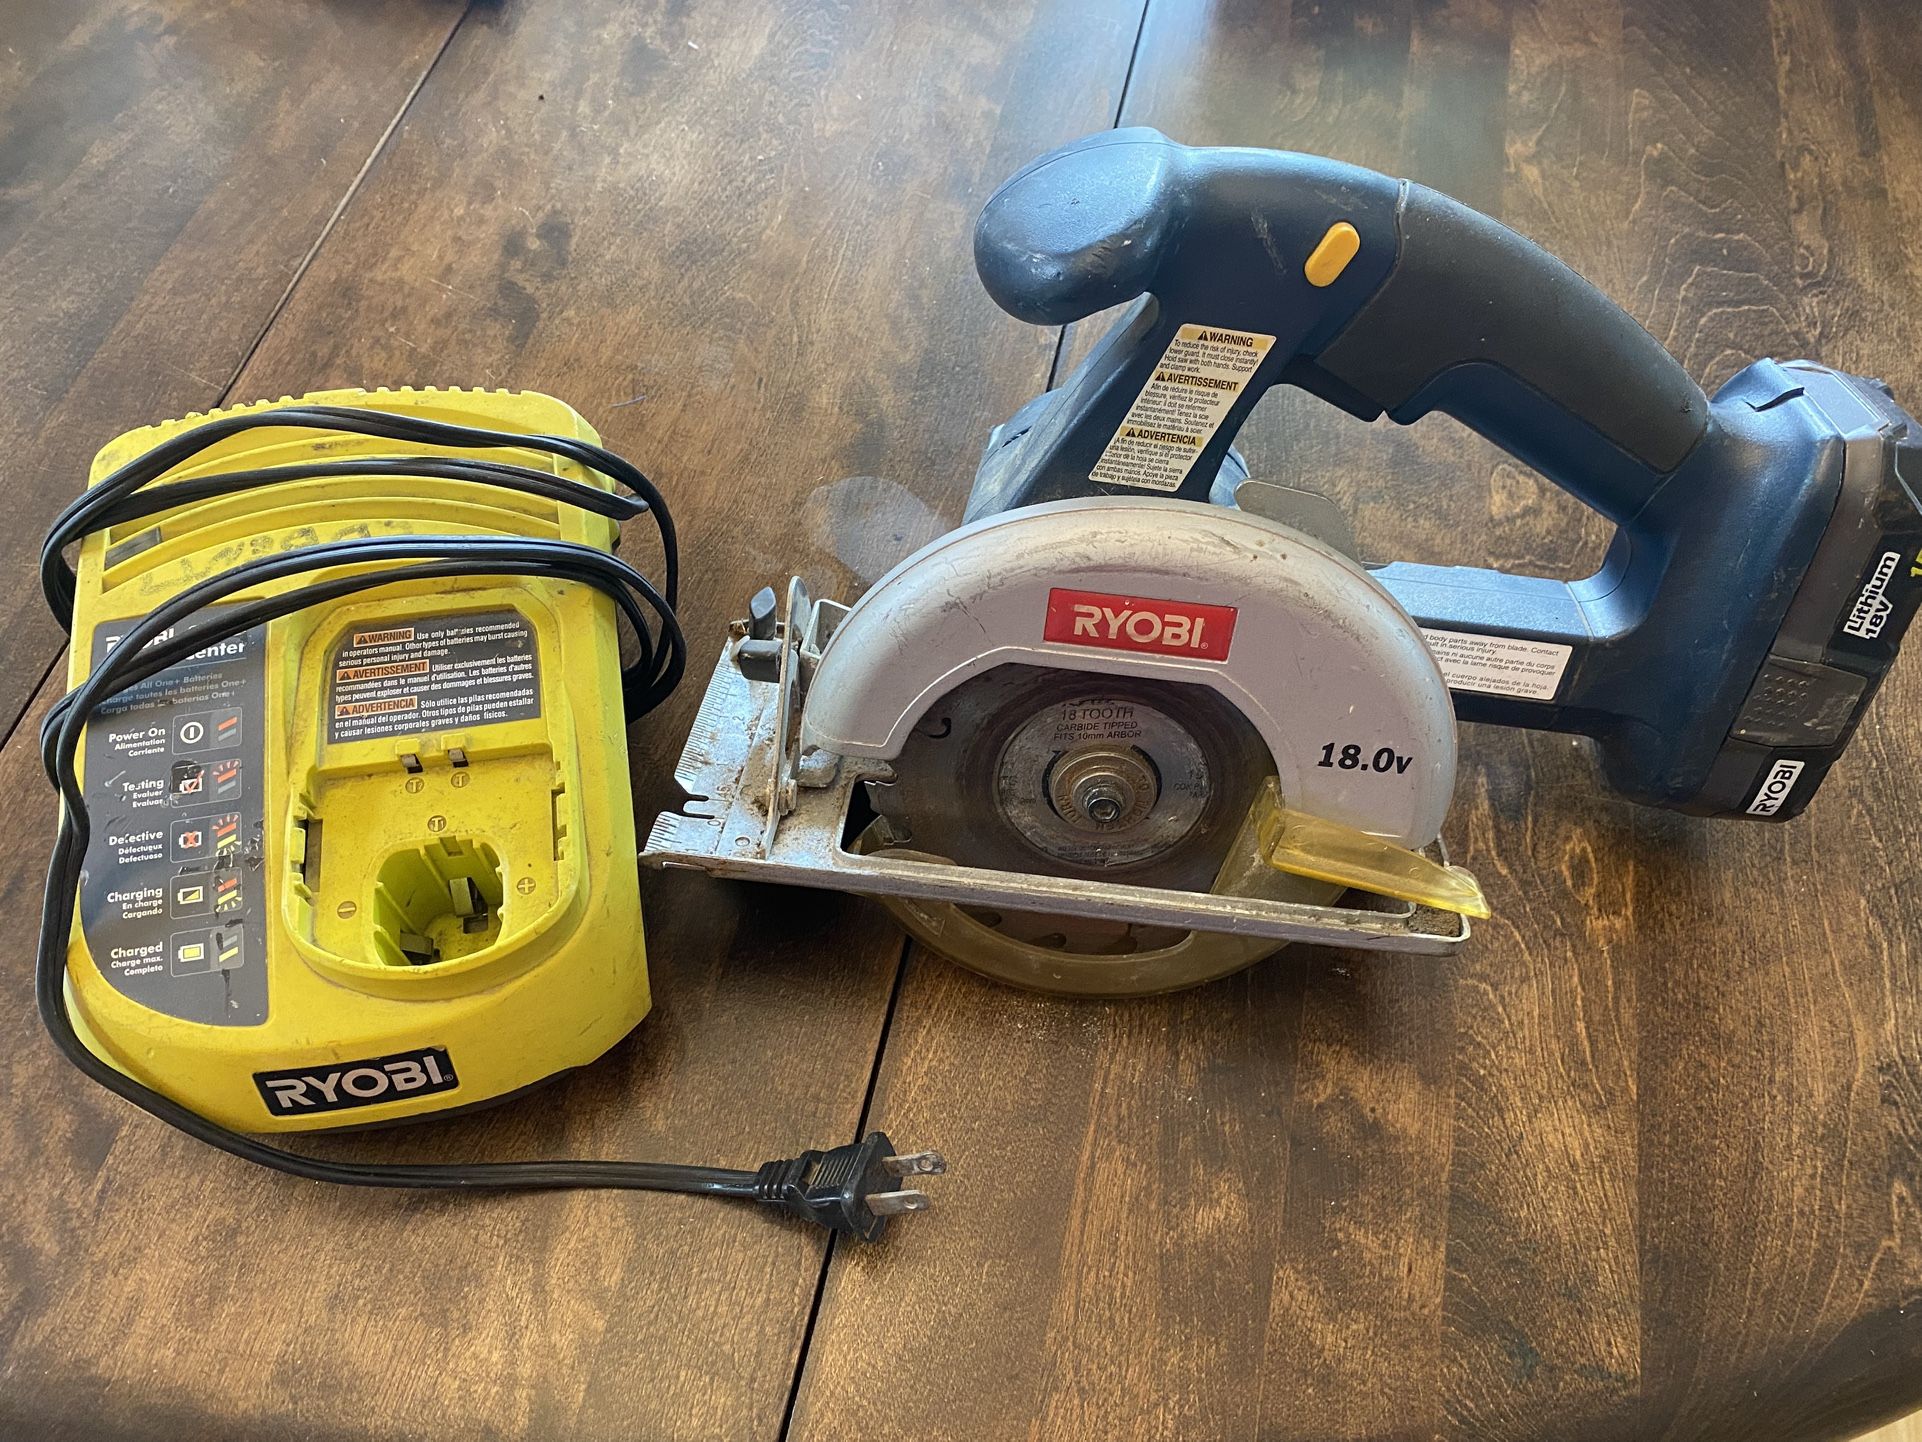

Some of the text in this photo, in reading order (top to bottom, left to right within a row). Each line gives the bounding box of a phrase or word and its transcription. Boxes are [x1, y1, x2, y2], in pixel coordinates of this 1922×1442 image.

[1174, 339, 1180, 347] To
[1181, 341, 1199, 349] reduce
[1209, 344, 1219, 352] risk
[1219, 345, 1226, 353] of
[1209, 331, 1254, 347] WARNING
[1169, 346, 1184, 355] lower
[1220, 354, 1234, 362] close
[1164, 354, 1176, 362] Hold
[1200, 359, 1212, 367] both
[1231, 363, 1252, 372] Support
[1170, 363, 1186, 372] clamp
[1166, 373, 1239, 391] AVERTISSEMENT
[1136, 429, 1197, 446] ADVERTENCIA
[1847, 556, 1896, 632] Lithium
[1865, 600, 1890, 635] 18V
[368, 630, 412, 644] WARNING
[431, 630, 444, 638] only
[475, 621, 519, 632] recommended
[1073, 604, 1205, 648] RYOBI
[349, 648, 378, 657] operators
[379, 644, 402, 653] manual.
[405, 642, 422, 650] Other
[422, 640, 439, 649] types
[439, 638, 446, 646] of
[446, 636, 473, 645] batteries
[487, 632, 503, 640] burst
[504, 630, 527, 638] causing
[1429, 635, 1447, 643] body
[1531, 647, 1559, 656] Contact
[339, 648, 450, 667] serious personal injury and damage.
[352, 662, 428, 679] AVERTISSEMENT
[432, 663, 453, 671] Utiliser
[454, 658, 495, 669] exclusivement
[506, 654, 532, 662] batteries
[140, 680, 153, 689] All
[183, 672, 223, 684] Batteries
[336, 681, 381, 692] recommandées
[383, 679, 397, 687] dans
[399, 677, 405, 685] le
[407, 674, 429, 683] manuel
[481, 666, 507, 674] batteries
[508, 663, 532, 671] d'autres
[135, 690, 163, 700] toutes
[165, 688, 178, 696] les
[180, 684, 219, 694] batteries
[335, 694, 351, 703] types
[352, 690, 376, 701] peuvent
[377, 688, 402, 697] exploser
[442, 679, 475, 688] dommages
[476, 677, 482, 685] et
[483, 675, 511, 683] blessures
[512, 672, 533, 681] graves.
[130, 701, 155, 710] todas
[351, 698, 415, 715] ADVERTENCIA
[420, 700, 435, 708] Sólo
[436, 698, 456, 706] utilice
[468, 694, 484, 704] pilas
[485, 688, 532, 700] recomendadas
[344, 719, 351, 727] el
[352, 716, 376, 726] manual
[377, 714, 388, 723] del
[389, 712, 420, 722] operador.
[421, 709, 439, 717] Otros
[440, 707, 456, 716] tipos
[457, 705, 465, 713] de
[466, 704, 482, 713] pilas
[483, 701, 507, 711] pueden
[508, 697, 533, 706] estallar
[1062, 706, 1135, 720] 18 TOOTH
[340, 728, 363, 737] causar
[364, 725, 392, 734] lesiones
[394, 720, 429, 730] corporales
[431, 717, 453, 727] graves
[454, 716, 458, 724] y
[460, 713, 480, 722] daños
[1056, 721, 1138, 732] CARBIDE TIPPED
[108, 728, 166, 743] Power On
[1053, 730, 1142, 741] FITS 10mm ARBOR
[114, 738, 166, 750] Alimentation
[128, 747, 165, 757] Corriente
[132, 790, 163, 799] Evaluer
[1752, 764, 1798, 813] RYOBI
[132, 799, 164, 808] Evaluar
[118, 843, 163, 855] Défectueux
[118, 852, 163, 864] Defectuoso
[106, 887, 163, 903] Charging
[122, 898, 163, 910] En charge
[122, 907, 163, 919] Cargando
[110, 941, 163, 959] Charged
[110, 956, 163, 969] Charge max.
[124, 964, 163, 976] Completo
[265, 1055, 444, 1108] RYOBI
